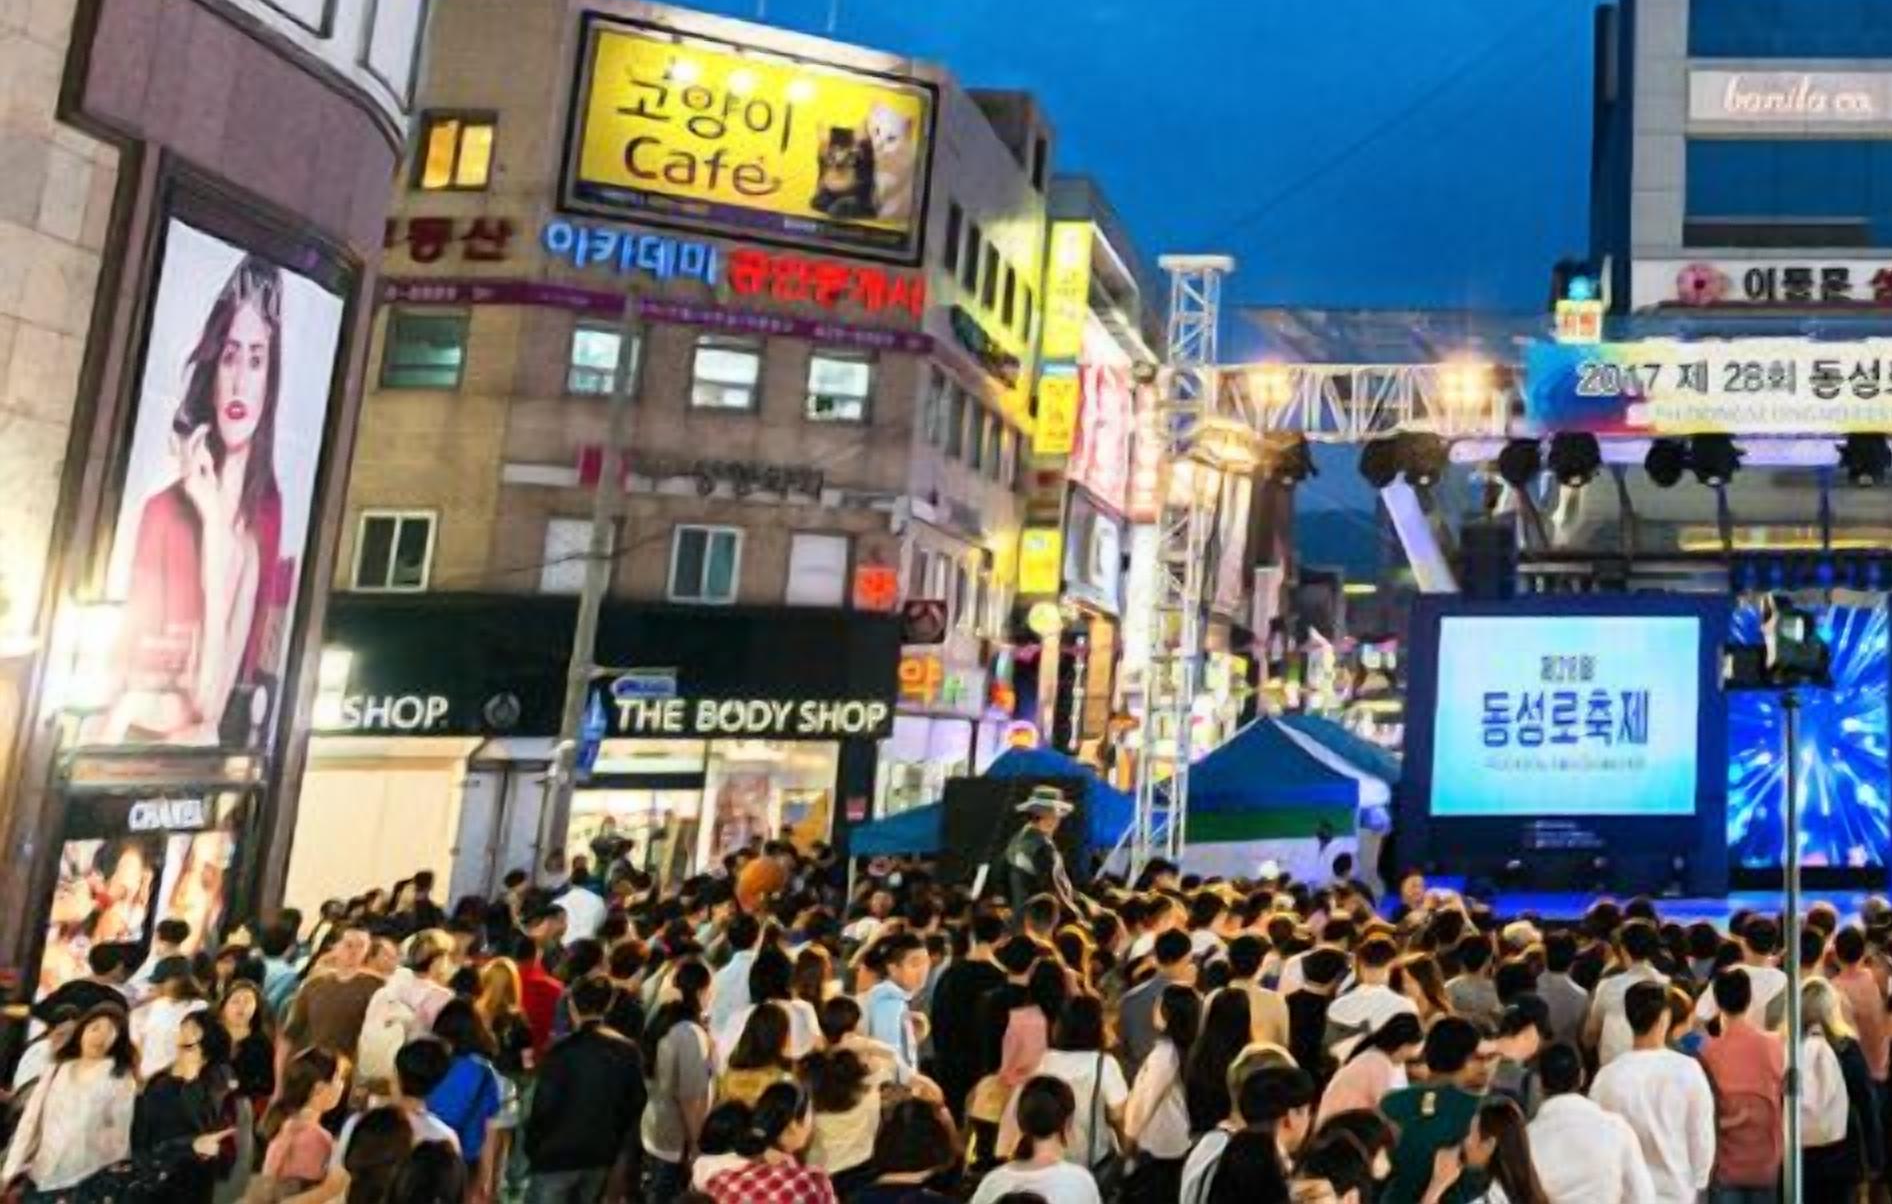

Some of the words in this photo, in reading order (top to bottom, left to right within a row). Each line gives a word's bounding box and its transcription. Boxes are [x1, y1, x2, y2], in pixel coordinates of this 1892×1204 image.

[616, 72, 794, 154] 고양이
[1723, 74, 1827, 115] banila
[385, 216, 513, 263] 동산
[543, 220, 717, 286] 아카데미
[1576, 362, 1661, 396] 2017
[1674, 359, 1708, 395] 제
[1722, 359, 1798, 395] 28회
[341, 696, 447, 730] SHOP
[614, 698, 686, 733] THE
[695, 698, 795, 734] BODY
[798, 700, 888, 734] SHOP
[1481, 689, 1650, 748] 동성로축제
